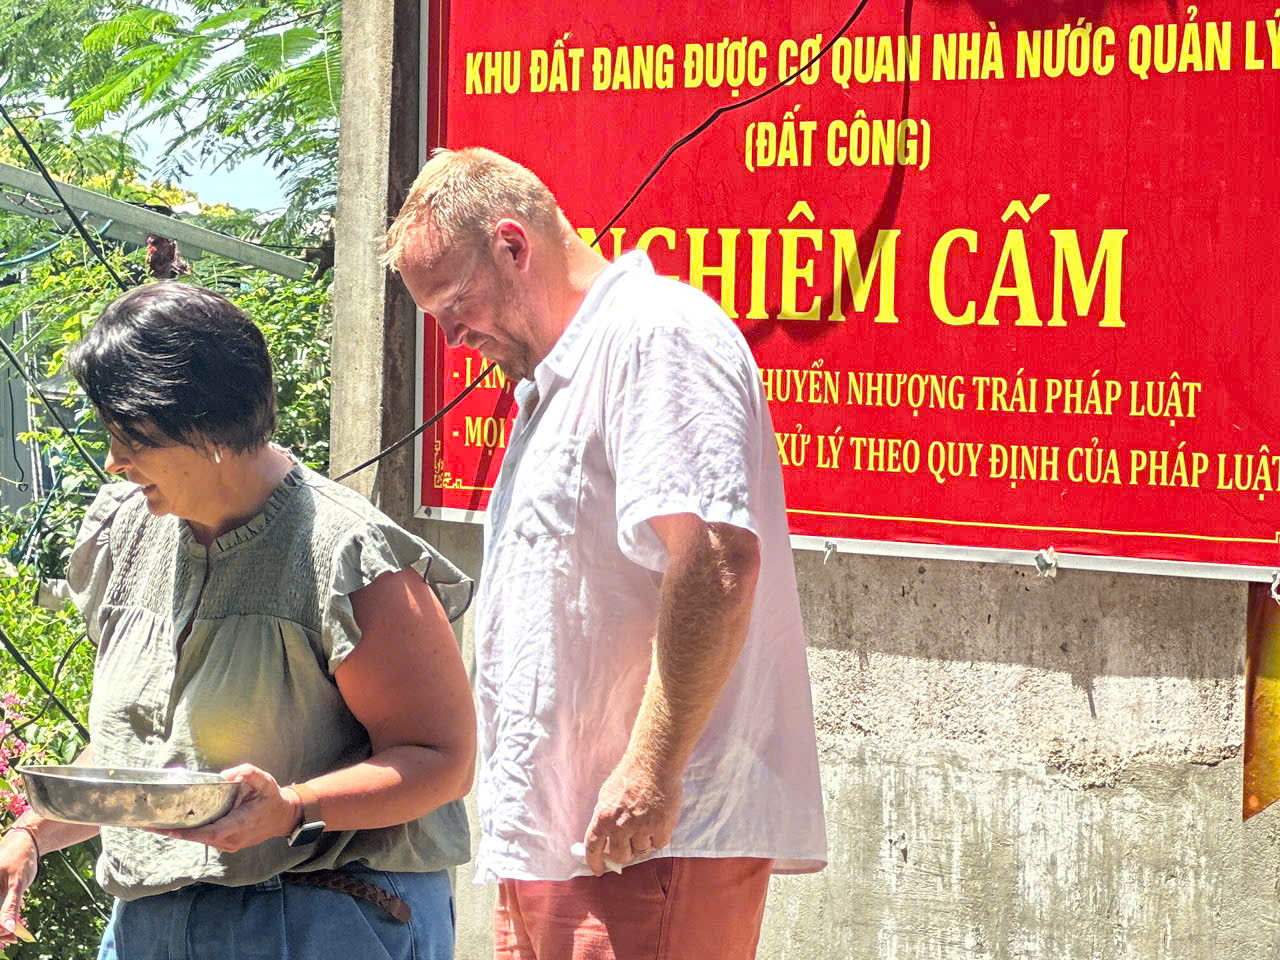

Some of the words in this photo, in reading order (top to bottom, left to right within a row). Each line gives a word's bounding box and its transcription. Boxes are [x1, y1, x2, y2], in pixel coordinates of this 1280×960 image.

[465, 50, 521, 95] KHU
[529, 32, 585, 93] ĐẤT
[592, 44, 675, 91] ĐANG
[683, 36, 768, 97] ĐƯỢC
[778, 33, 823, 86] CƠ
[831, 34, 921, 89] QUAN
[932, 21, 1004, 81] NHÀ
[1016, 17, 1116, 78] NƯỚC
[1128, 5, 1232, 79] QUẢN
[1245, 8, 1280, 70] LÝ
[745, 104, 818, 172] (ĐẤT
[827, 109, 931, 170] CÔNG)
[928, 193, 1129, 328] CẤM
[758, 358, 841, 404] HUYỂN
[847, 371, 966, 417] NHƯỢNG
[972, 367, 1038, 414] TRÁI
[1045, 368, 1122, 415] PHÁP
[1129, 371, 1202, 427] LUẬT
[464, 415, 506, 456] MỌI
[775, 423, 811, 467] XỬ
[816, 425, 845, 469] LÝ
[850, 436, 921, 474] THEO
[927, 440, 984, 484] QUY
[989, 444, 1060, 489] ĐỊNH
[1067, 436, 1122, 485] CỦA
[1129, 440, 1209, 487] PHÁP
